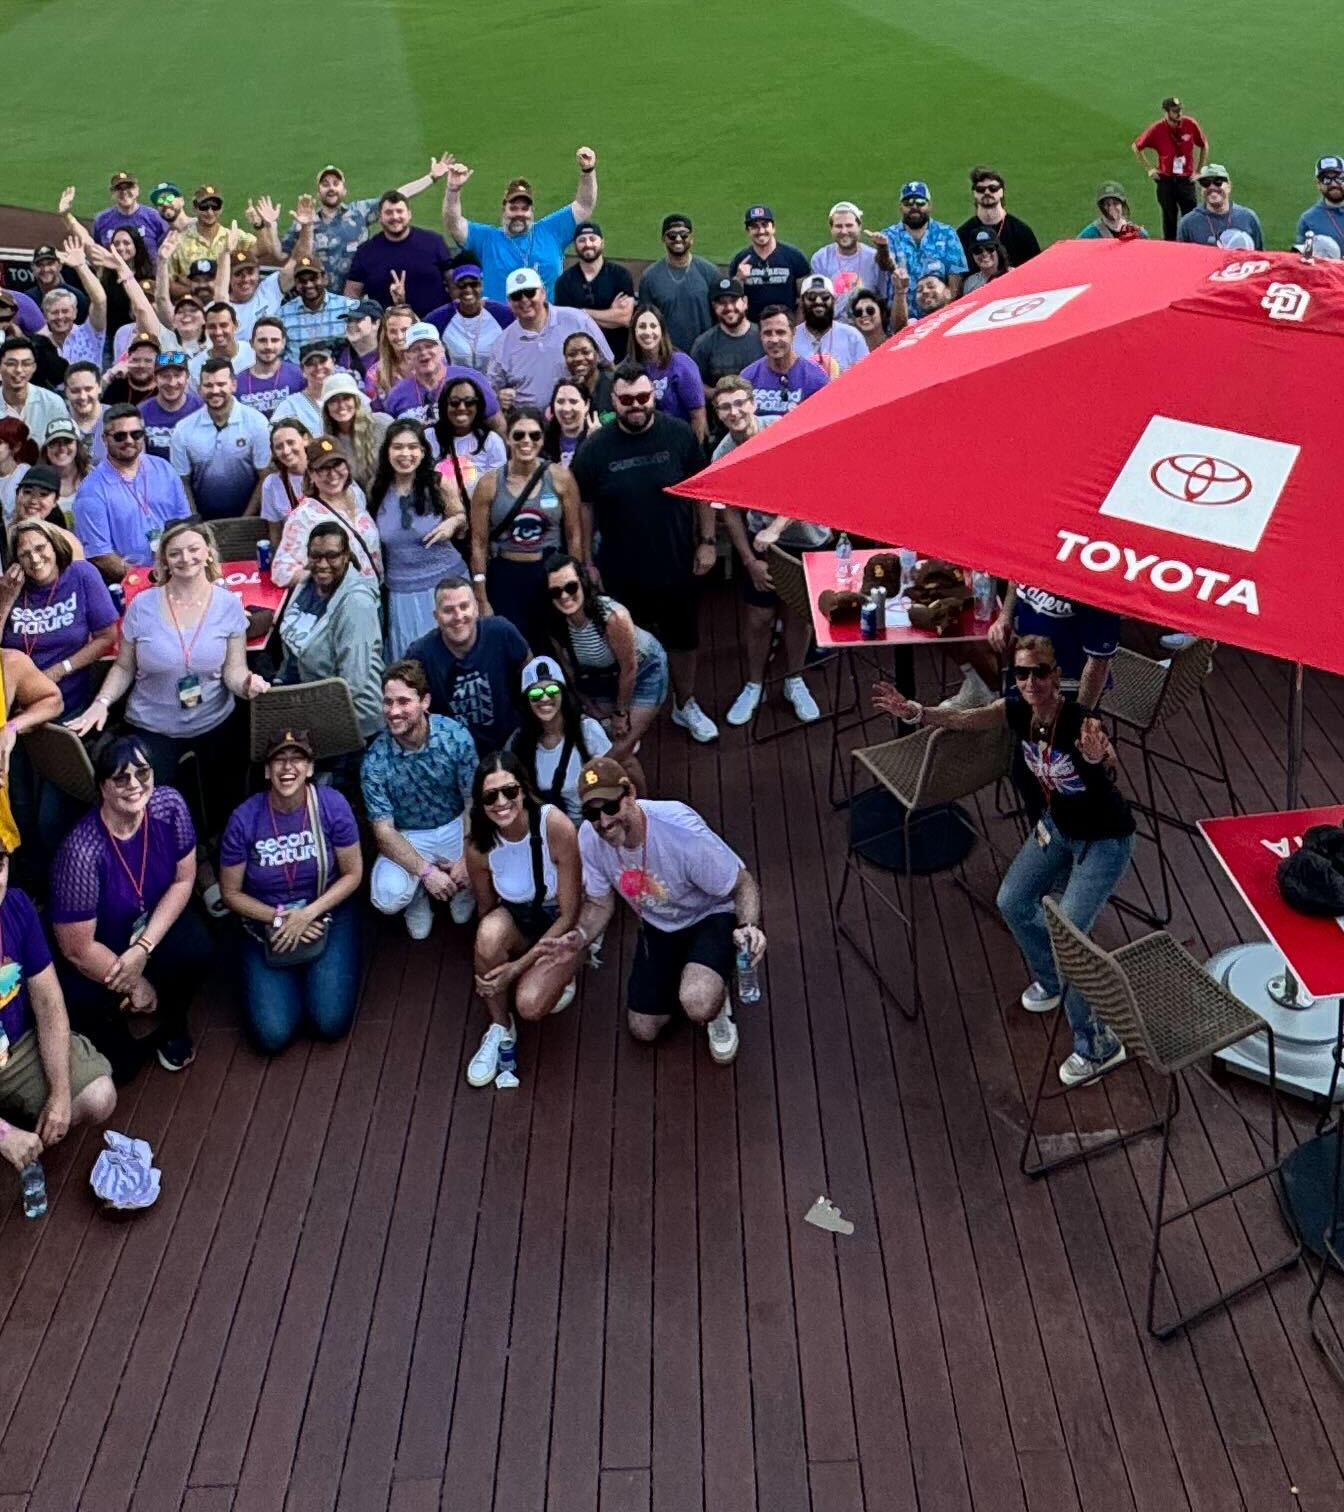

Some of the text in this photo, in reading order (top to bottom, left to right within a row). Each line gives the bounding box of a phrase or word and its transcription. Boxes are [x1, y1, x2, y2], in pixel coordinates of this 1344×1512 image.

[9, 267, 37, 282] TOY
[1260, 282, 1311, 322] SD
[1055, 529, 1261, 616] TOYOTA
[10, 592, 78, 624] second
[12, 606, 76, 636] nature
[255, 829, 314, 853] secon
[259, 844, 318, 867] natur
